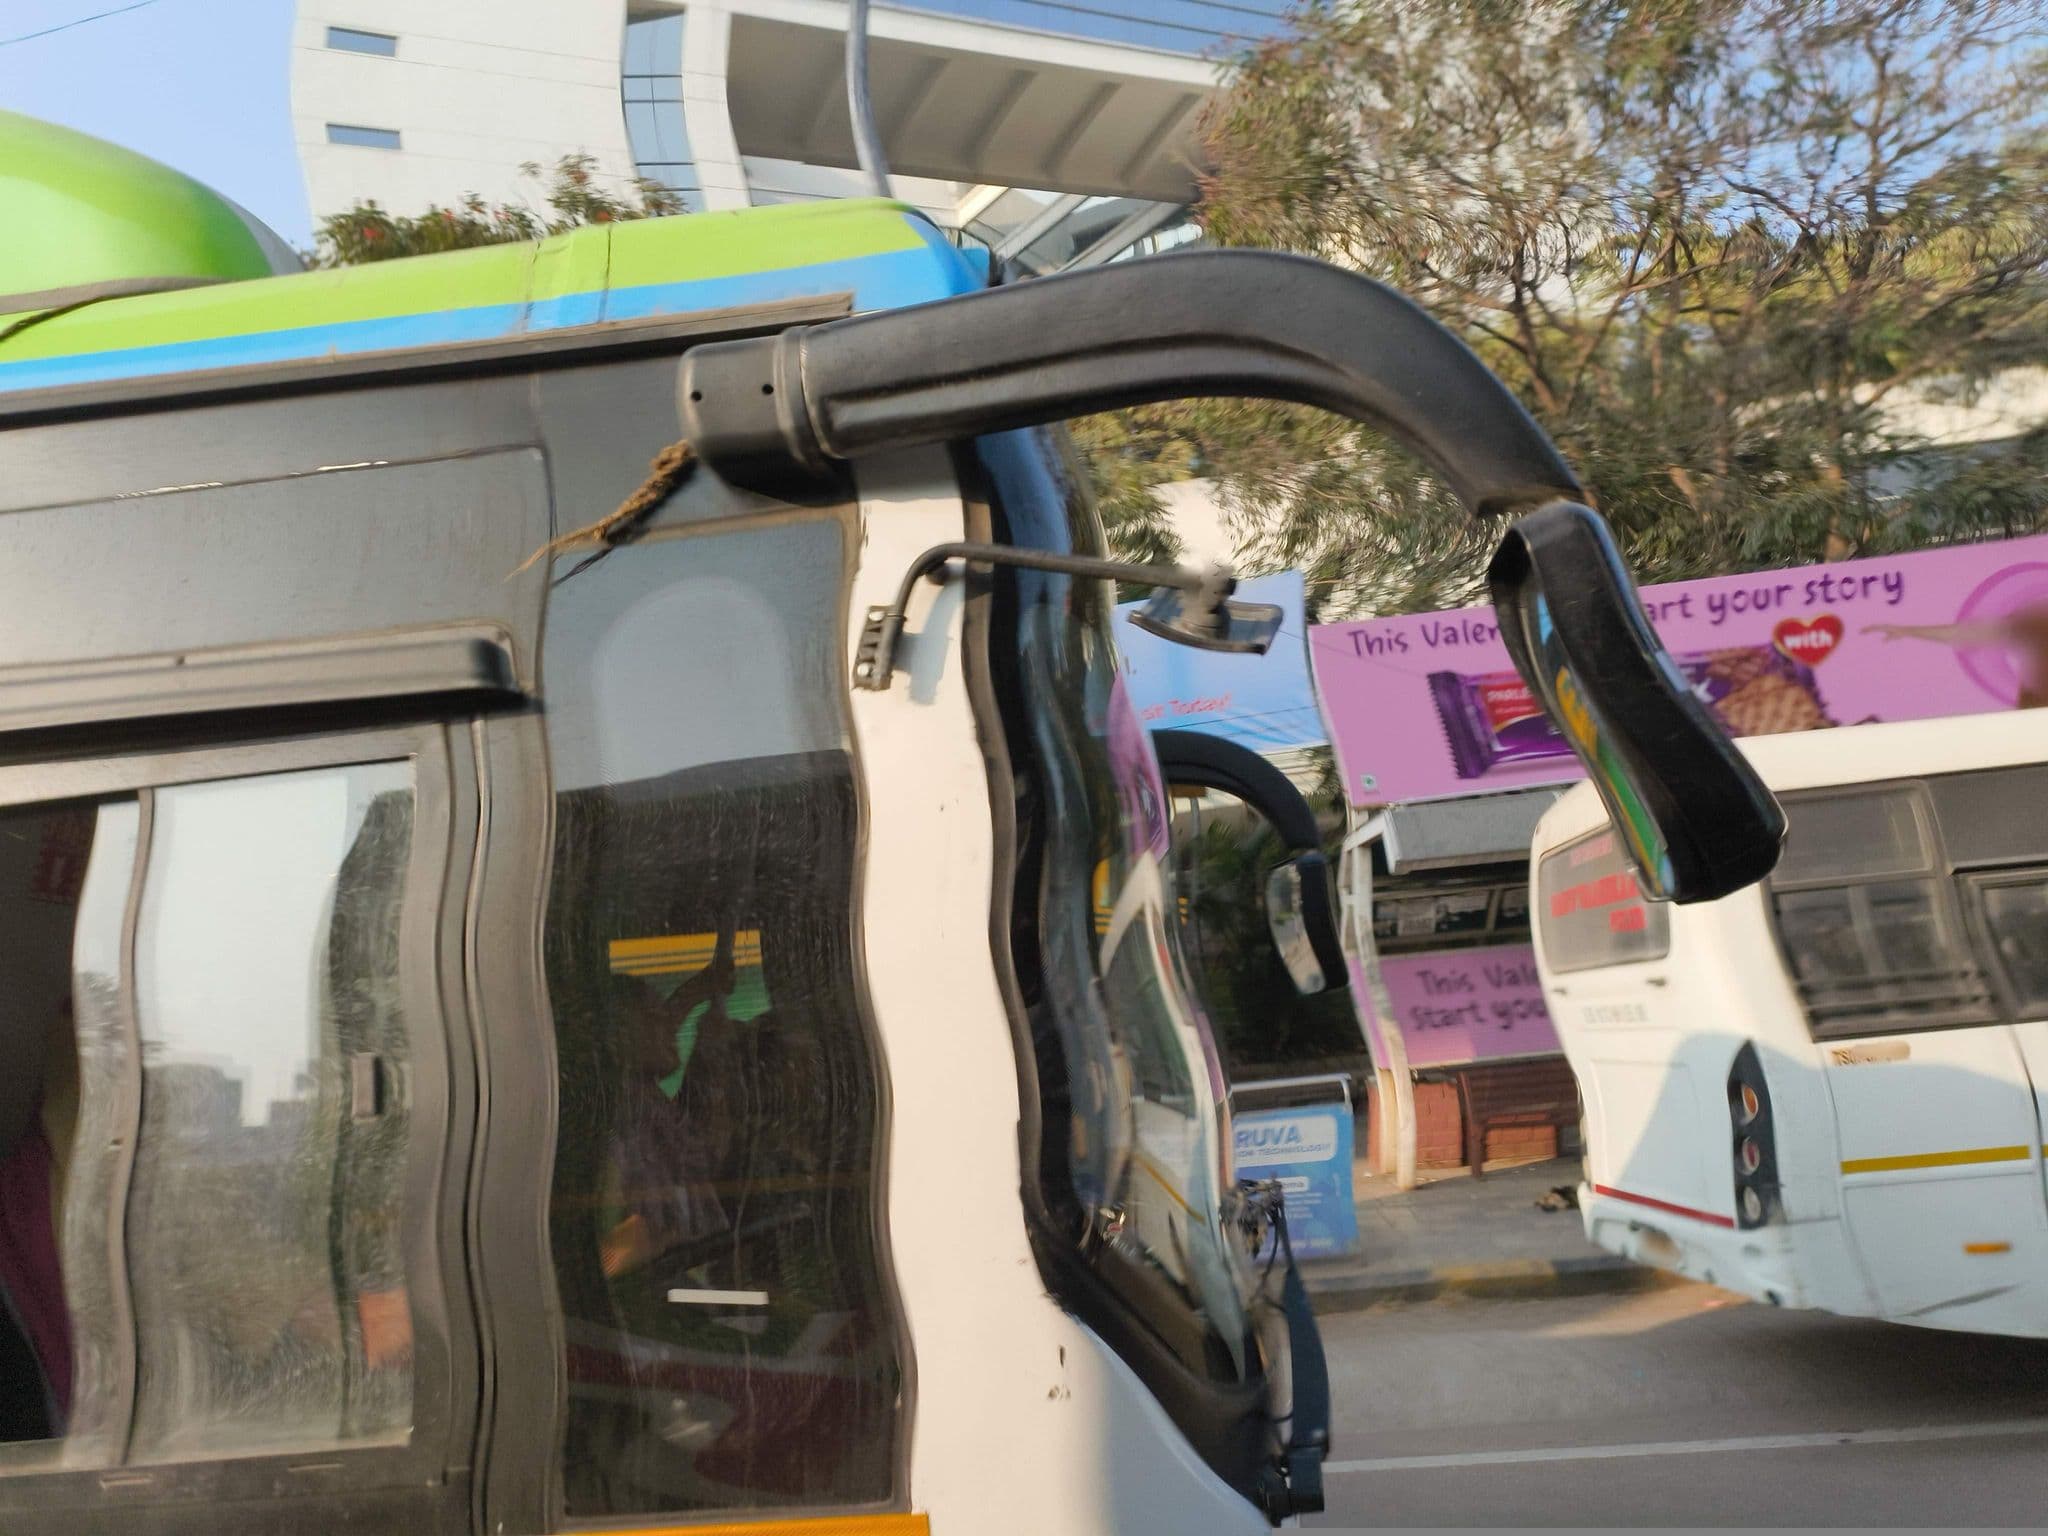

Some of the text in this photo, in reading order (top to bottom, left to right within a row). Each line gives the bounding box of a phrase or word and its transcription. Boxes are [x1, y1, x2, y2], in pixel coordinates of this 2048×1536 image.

[1348, 628, 1409, 657] This
[1707, 583, 1793, 626] your
[1804, 570, 1905, 606] story
[1784, 628, 1833, 651] with
[1416, 969, 1475, 996] This
[1409, 1002, 1486, 1030] Start
